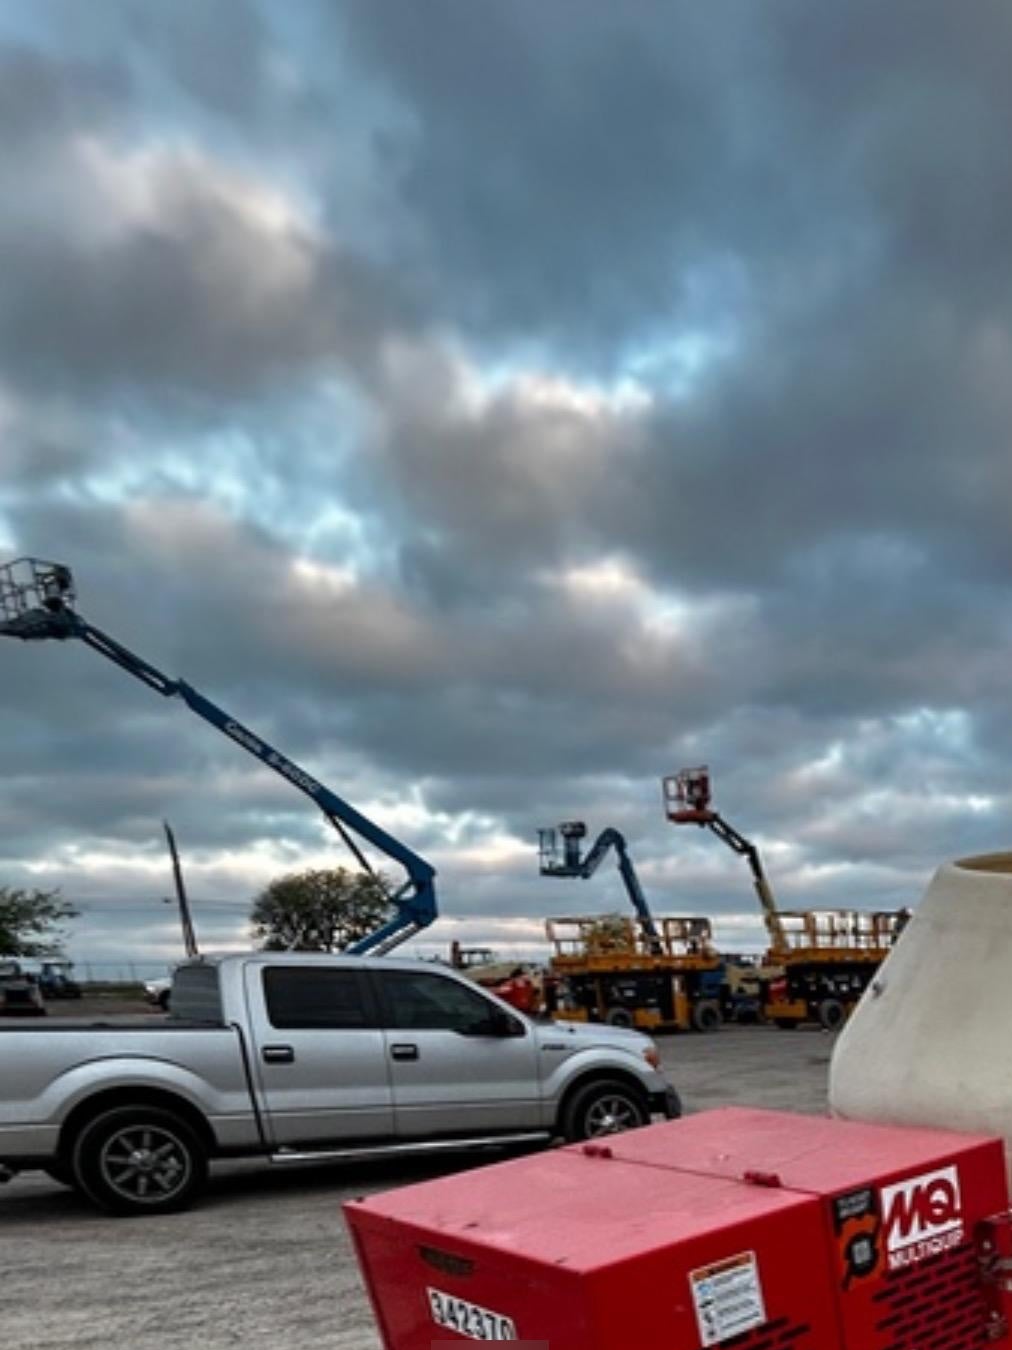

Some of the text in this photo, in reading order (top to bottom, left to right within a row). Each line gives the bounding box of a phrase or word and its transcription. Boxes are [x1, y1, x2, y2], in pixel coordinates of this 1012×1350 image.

[882, 1176, 961, 1246] MQ
[887, 1229, 964, 1270] MULTIQUIP
[431, 1291, 518, 1341] 342370
